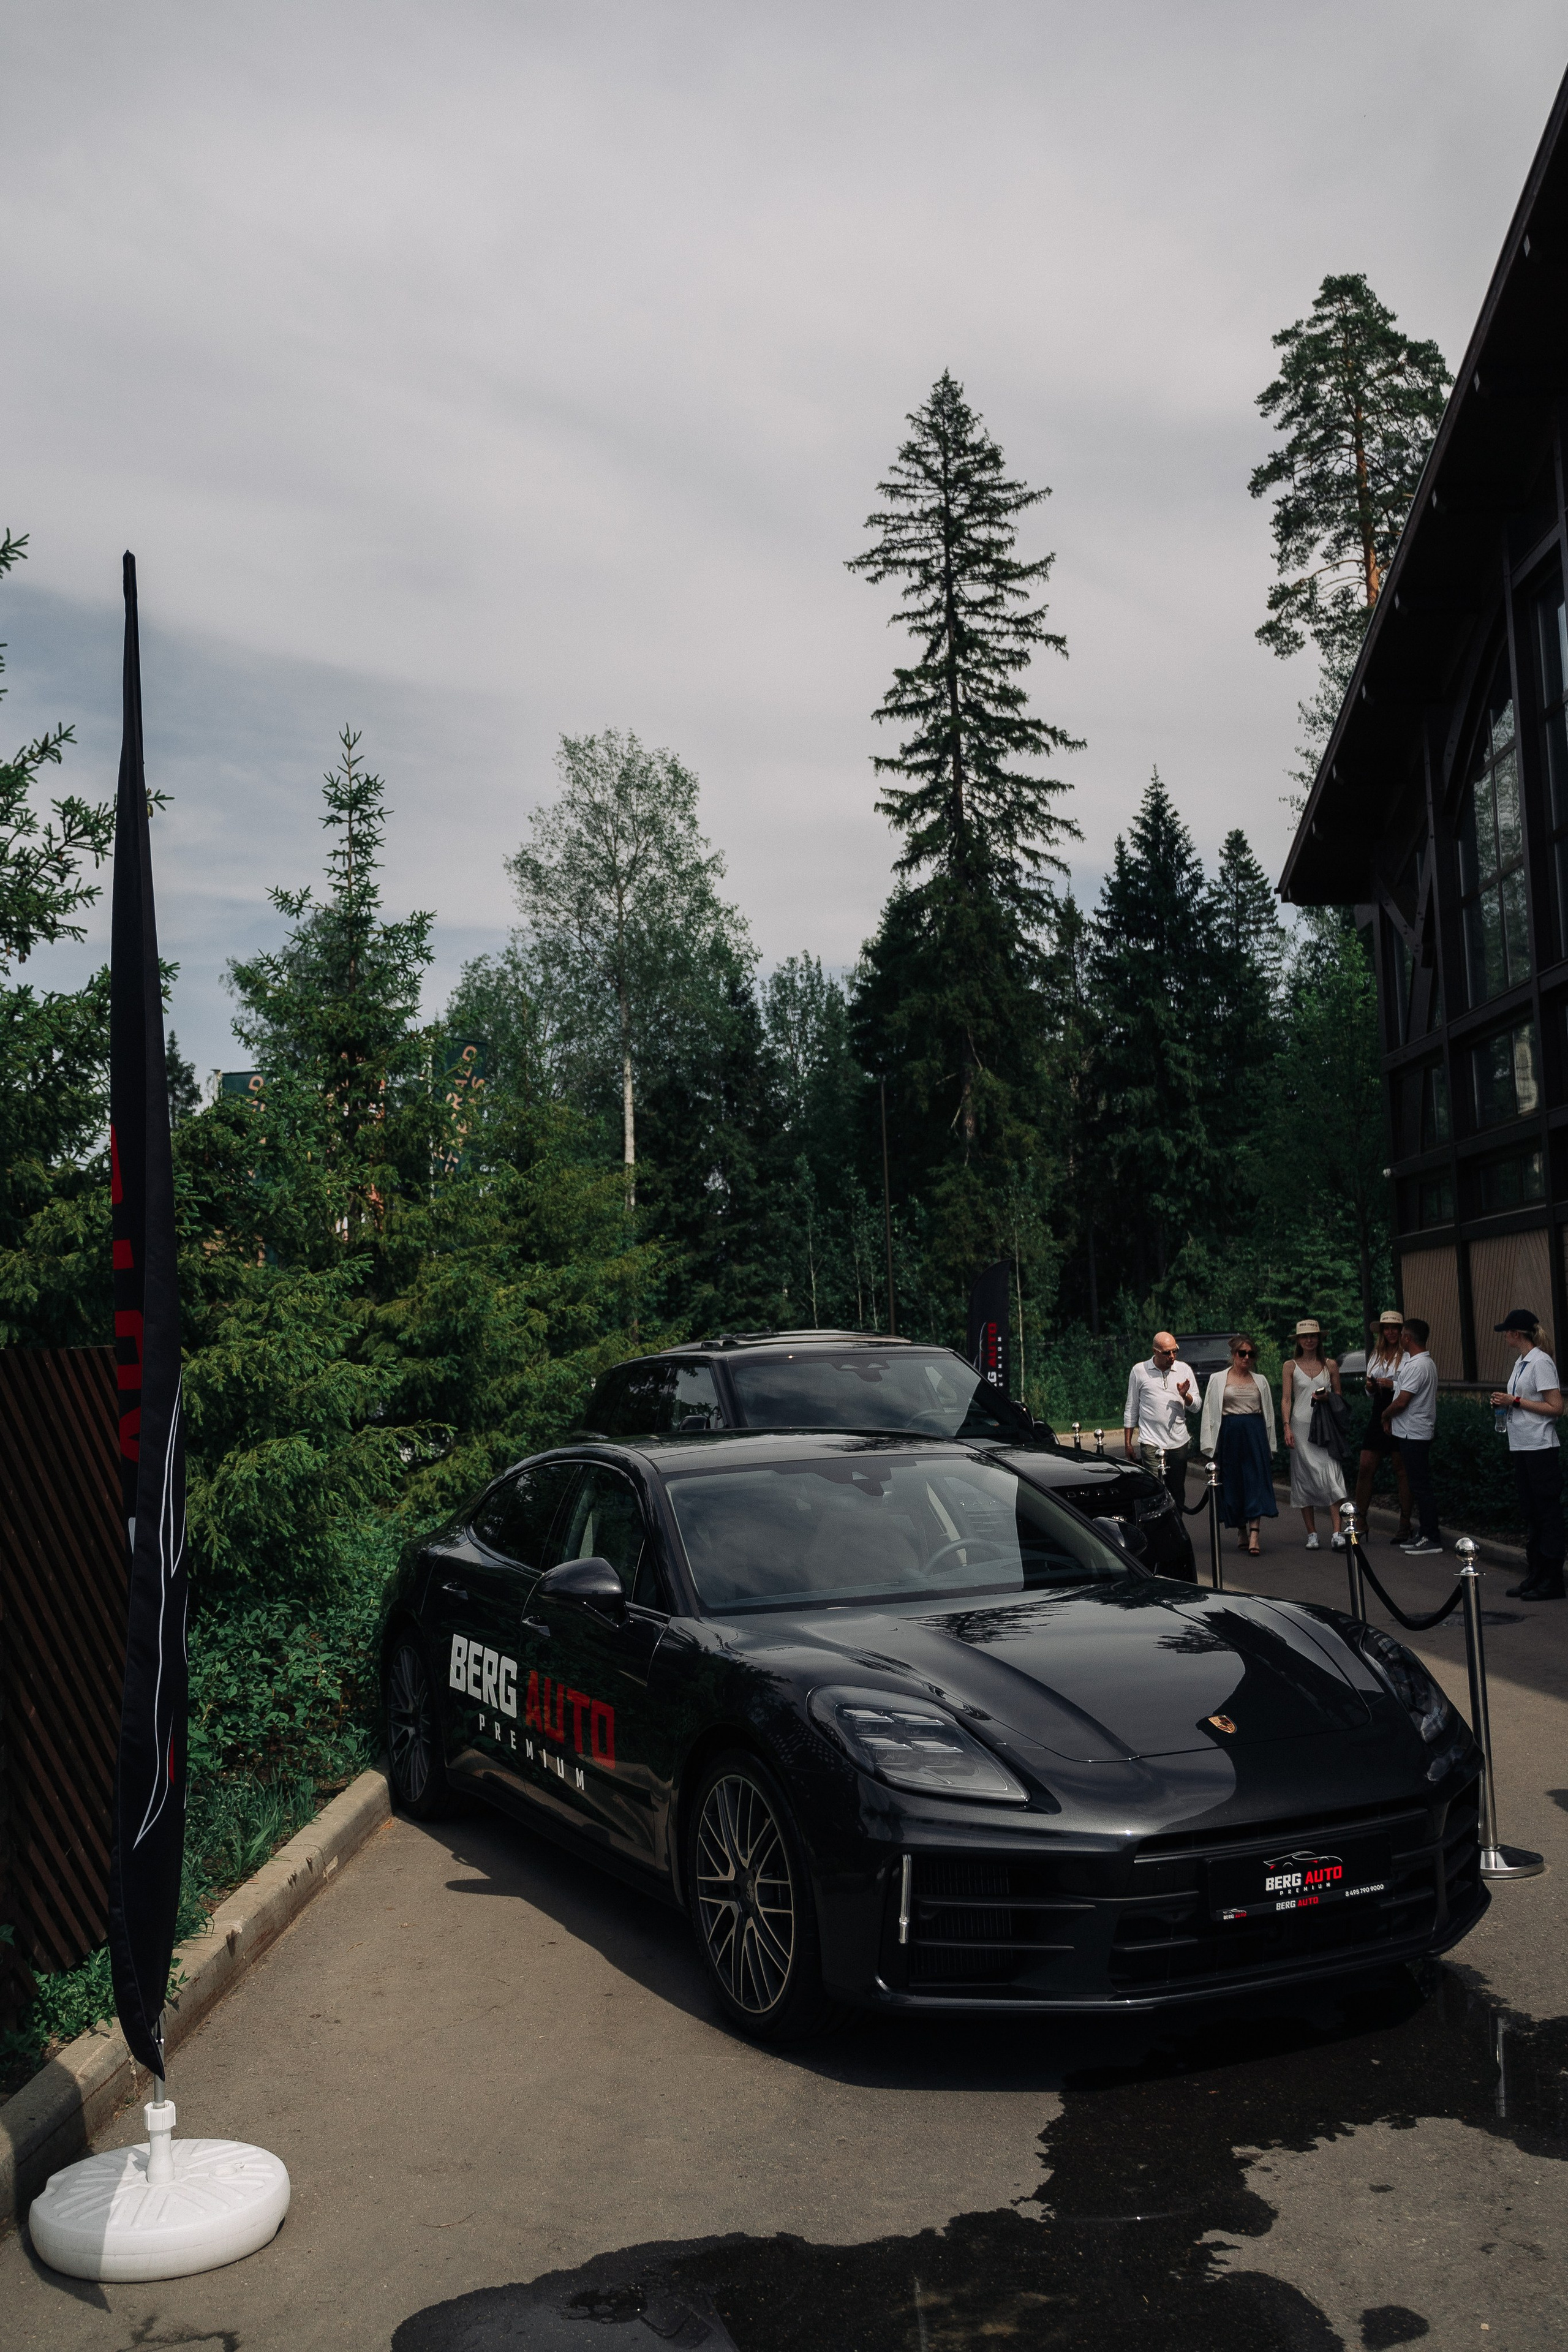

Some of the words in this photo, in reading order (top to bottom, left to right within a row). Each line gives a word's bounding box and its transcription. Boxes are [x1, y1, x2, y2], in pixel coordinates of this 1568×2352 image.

[987, 1322, 997, 1368] AUTO
[1066, 1487, 1121, 1498] OVER
[450, 1634, 518, 1719] BERG
[526, 1668, 616, 1770] AUTO
[479, 1713, 585, 1791] PREMIUM
[1265, 1872, 1302, 1891] BERG
[1305, 1865, 1343, 1885] AUTO
[1280, 1882, 1332, 1896] PREMIUM
[1276, 1900, 1296, 1911] BERG
[1297, 1896, 1319, 1907] AUTO
